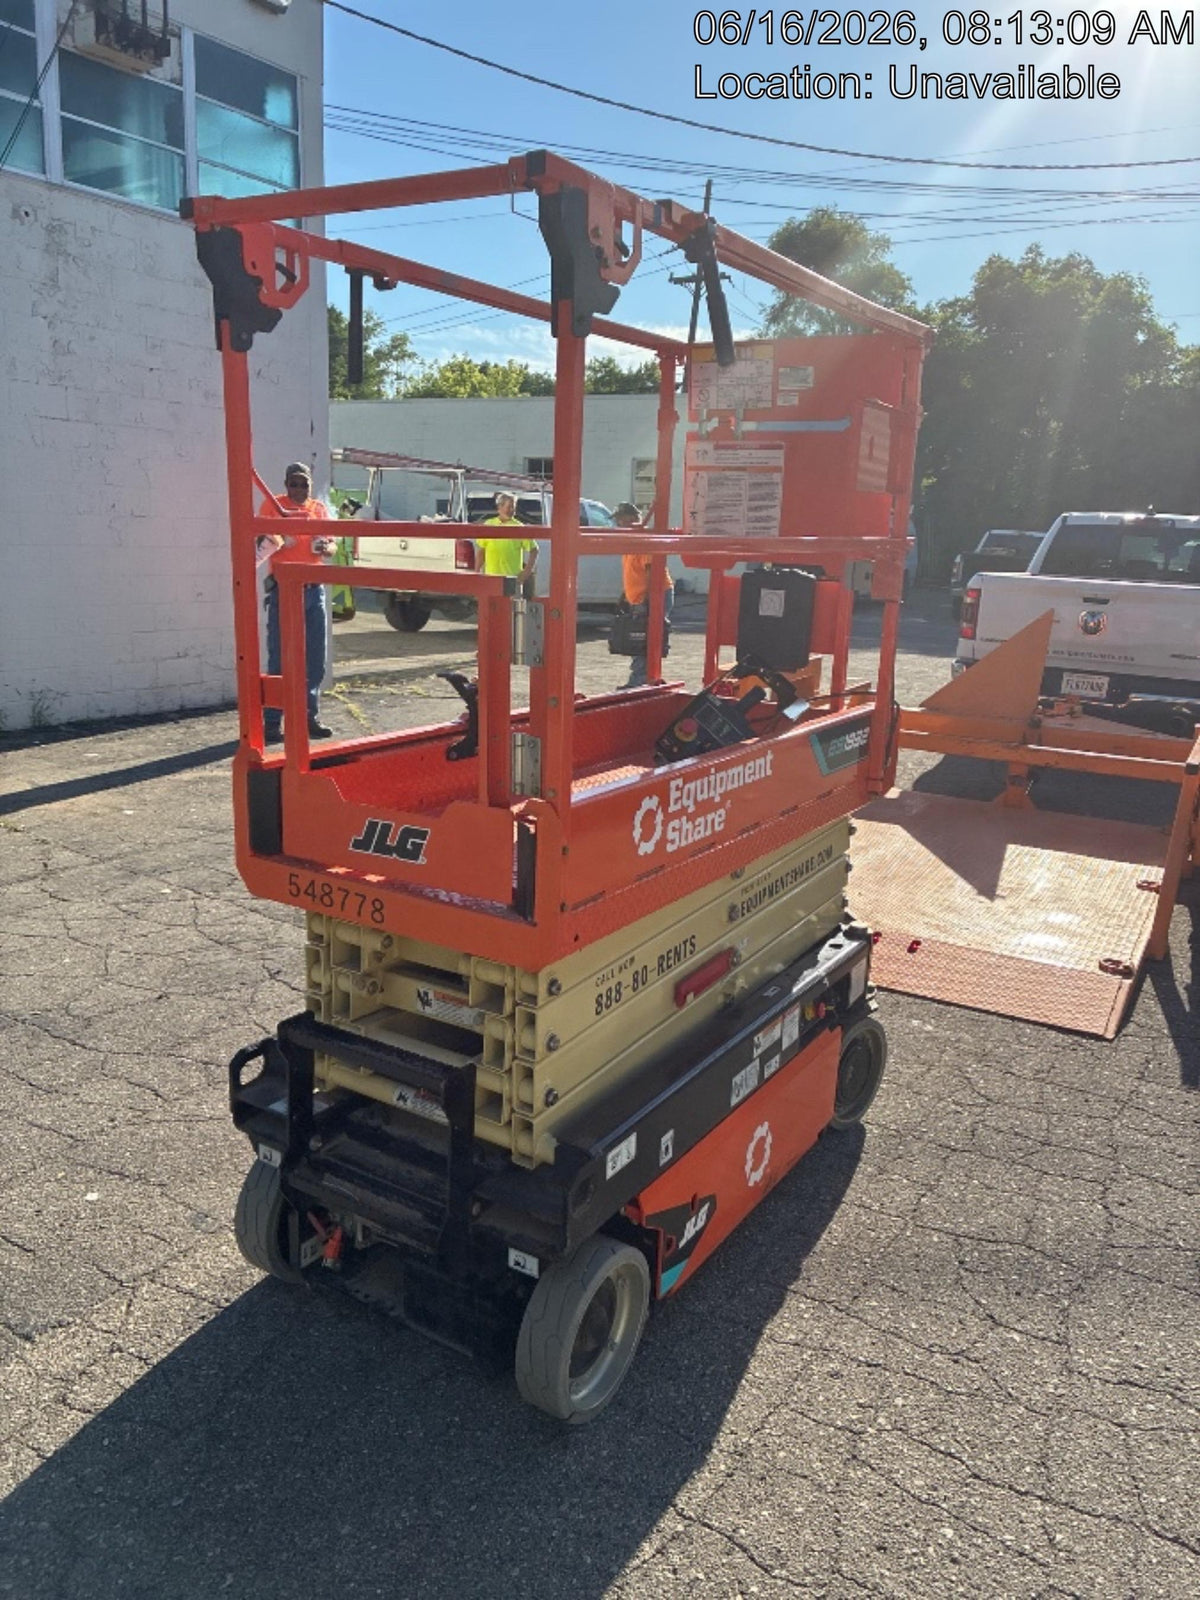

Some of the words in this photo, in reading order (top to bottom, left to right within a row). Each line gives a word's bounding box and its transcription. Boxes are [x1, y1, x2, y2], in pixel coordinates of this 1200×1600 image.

[668, 750, 774, 813] Equipment
[348, 817, 430, 864] JLG
[666, 808, 726, 852] Share
[288, 873, 385, 924] 548778
[594, 934, 696, 1016] 888-80-RENTS
[678, 1201, 711, 1249] JLG
